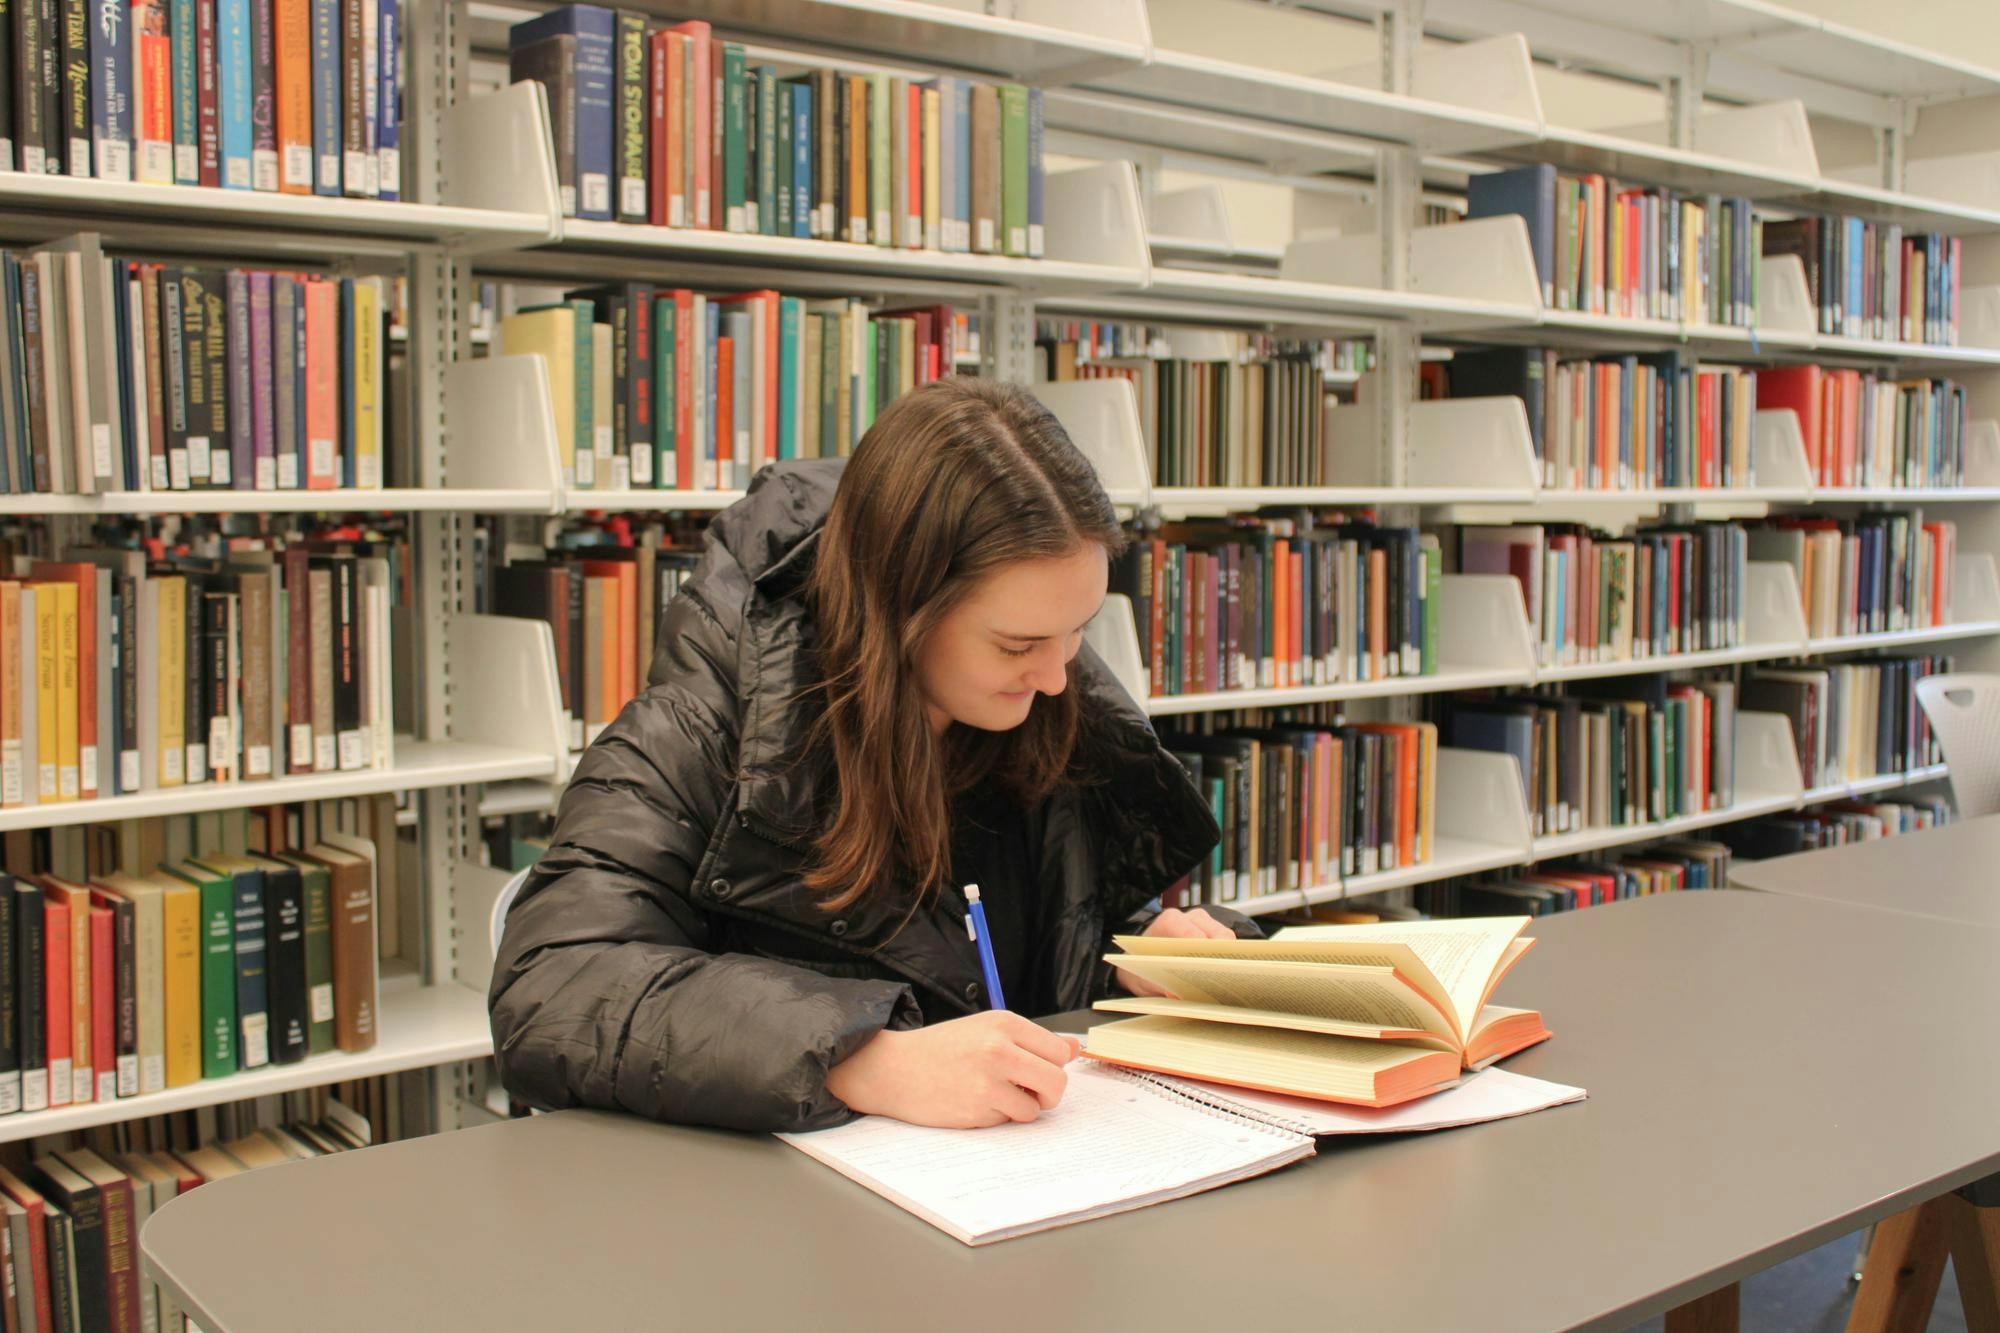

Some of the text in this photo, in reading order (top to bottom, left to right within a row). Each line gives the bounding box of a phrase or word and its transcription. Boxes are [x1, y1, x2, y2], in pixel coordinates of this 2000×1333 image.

[67, 60, 88, 129] Nocturne
[623, 32, 645, 178] TOM STOPPARD
